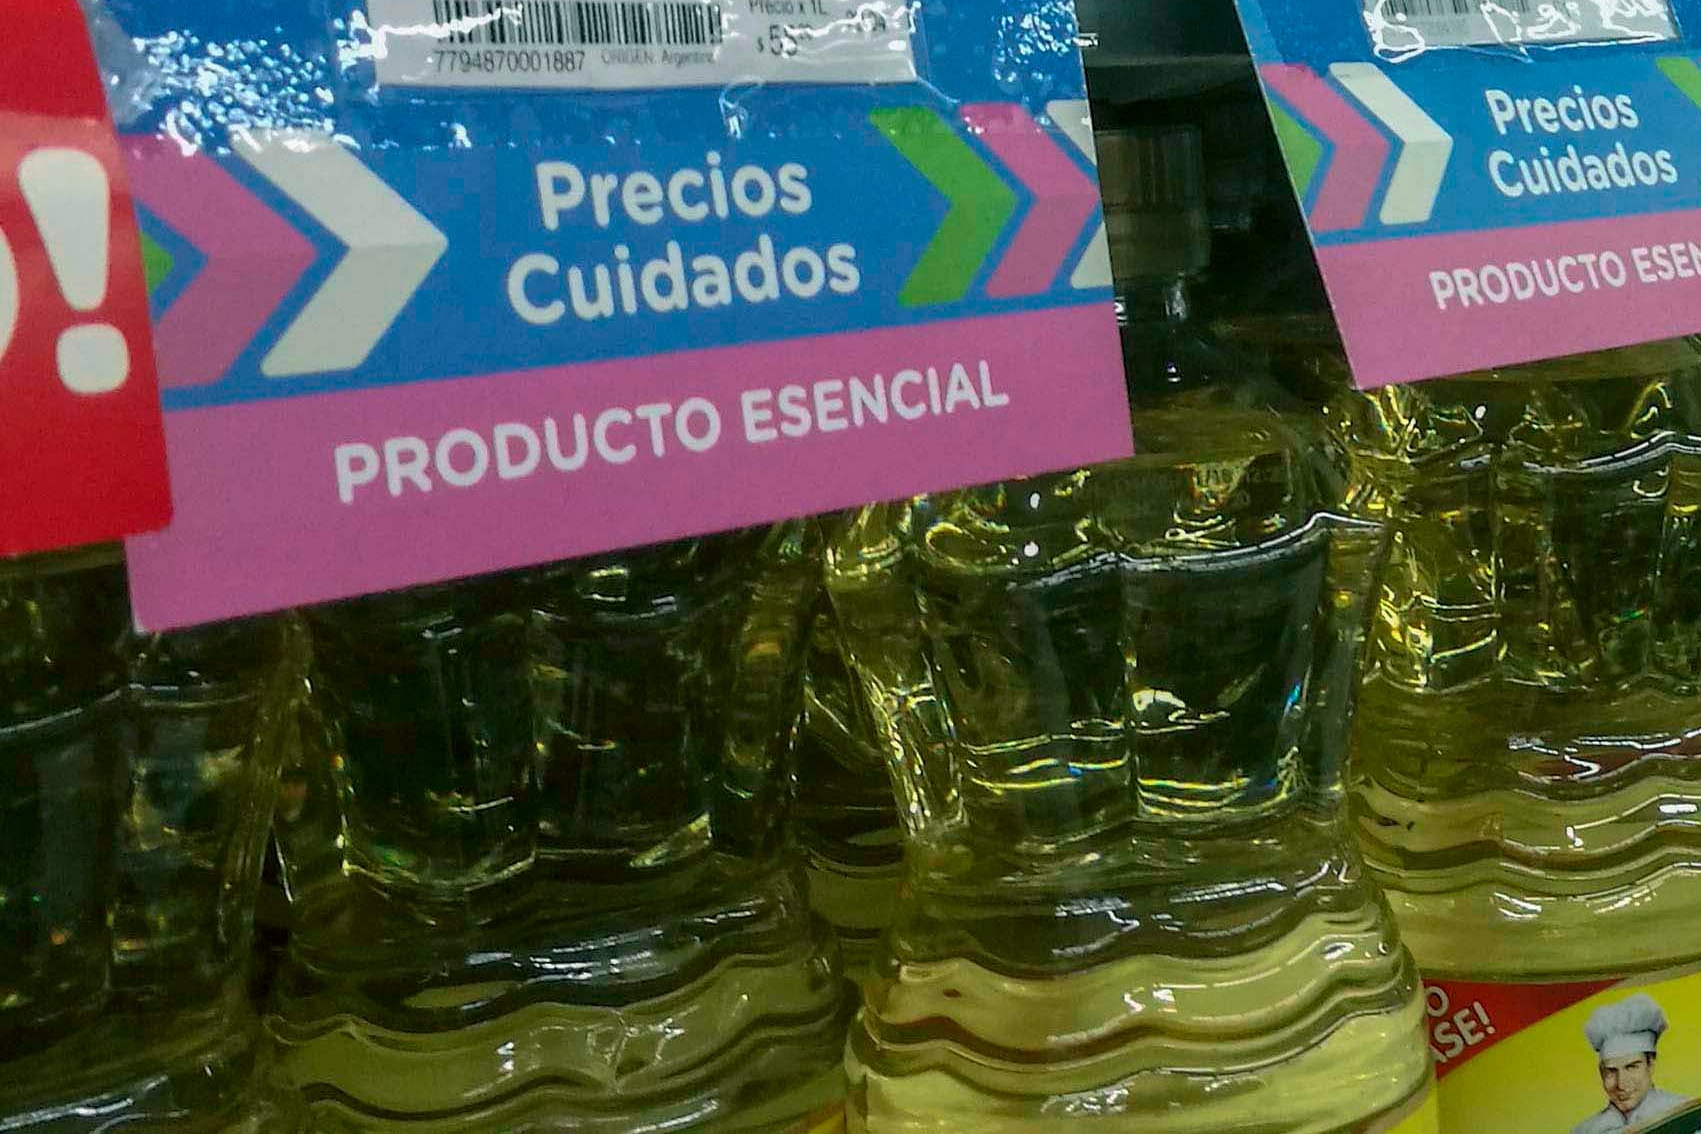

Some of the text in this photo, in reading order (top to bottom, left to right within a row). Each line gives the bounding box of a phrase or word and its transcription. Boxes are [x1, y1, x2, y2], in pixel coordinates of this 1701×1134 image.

[434, 50, 586, 74] 7794870001887
[1484, 84, 1640, 136] Precios
[535, 150, 813, 231] Precios
[1487, 141, 1679, 198] Cuidados
[506, 233, 861, 326] Cuidados
[1428, 249, 1627, 311] PRODUCTO
[333, 359, 1010, 505] PRODUCTO ESENCIAL
